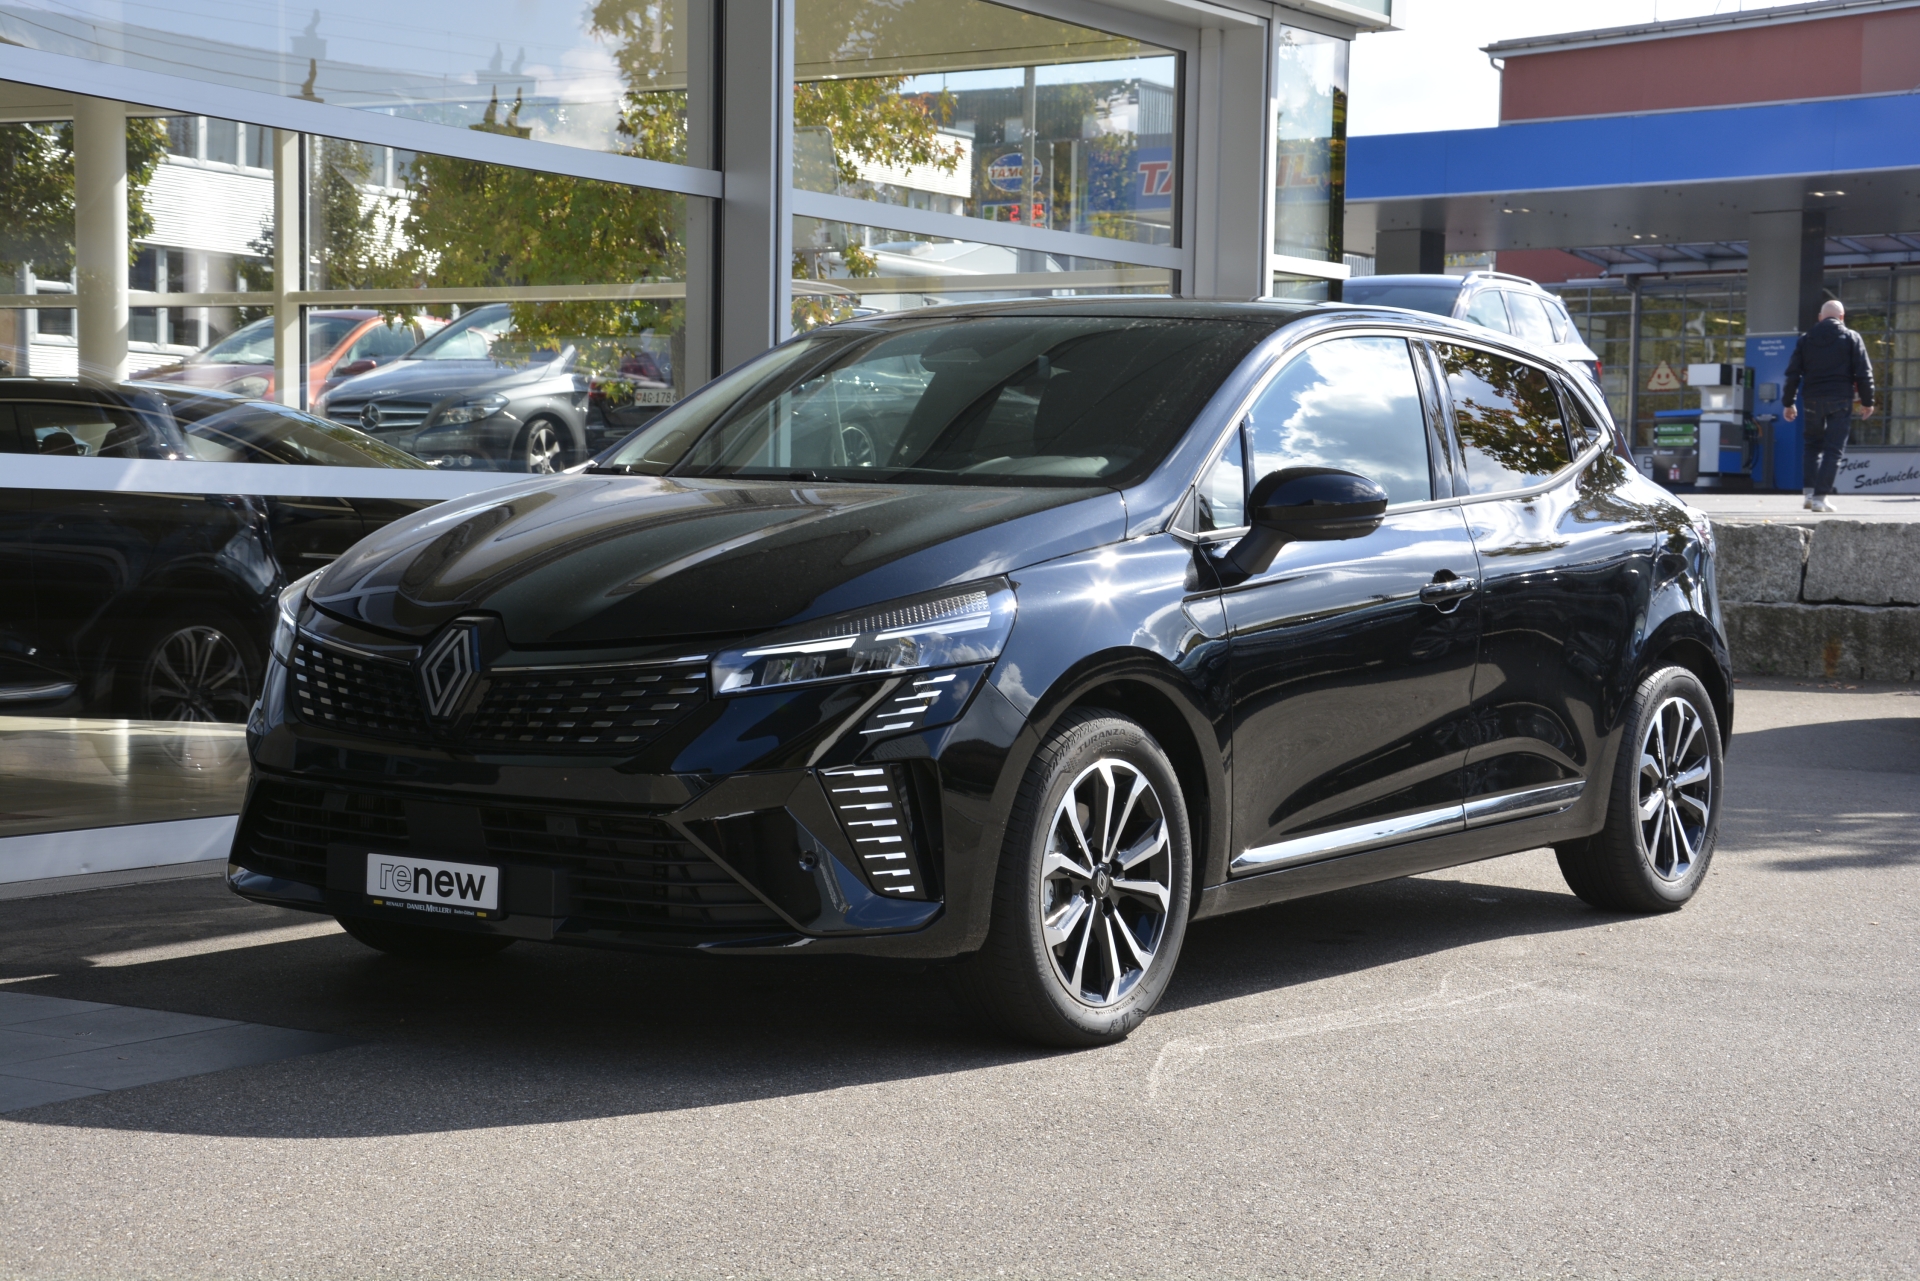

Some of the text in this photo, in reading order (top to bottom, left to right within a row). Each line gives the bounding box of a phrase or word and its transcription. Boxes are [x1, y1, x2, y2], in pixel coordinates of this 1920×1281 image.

[990, 166, 1042, 178] TAML
[1839, 458, 1871, 474] Feine
[1077, 728, 1126, 752] TURANZA
[380, 863, 486, 901] renew
